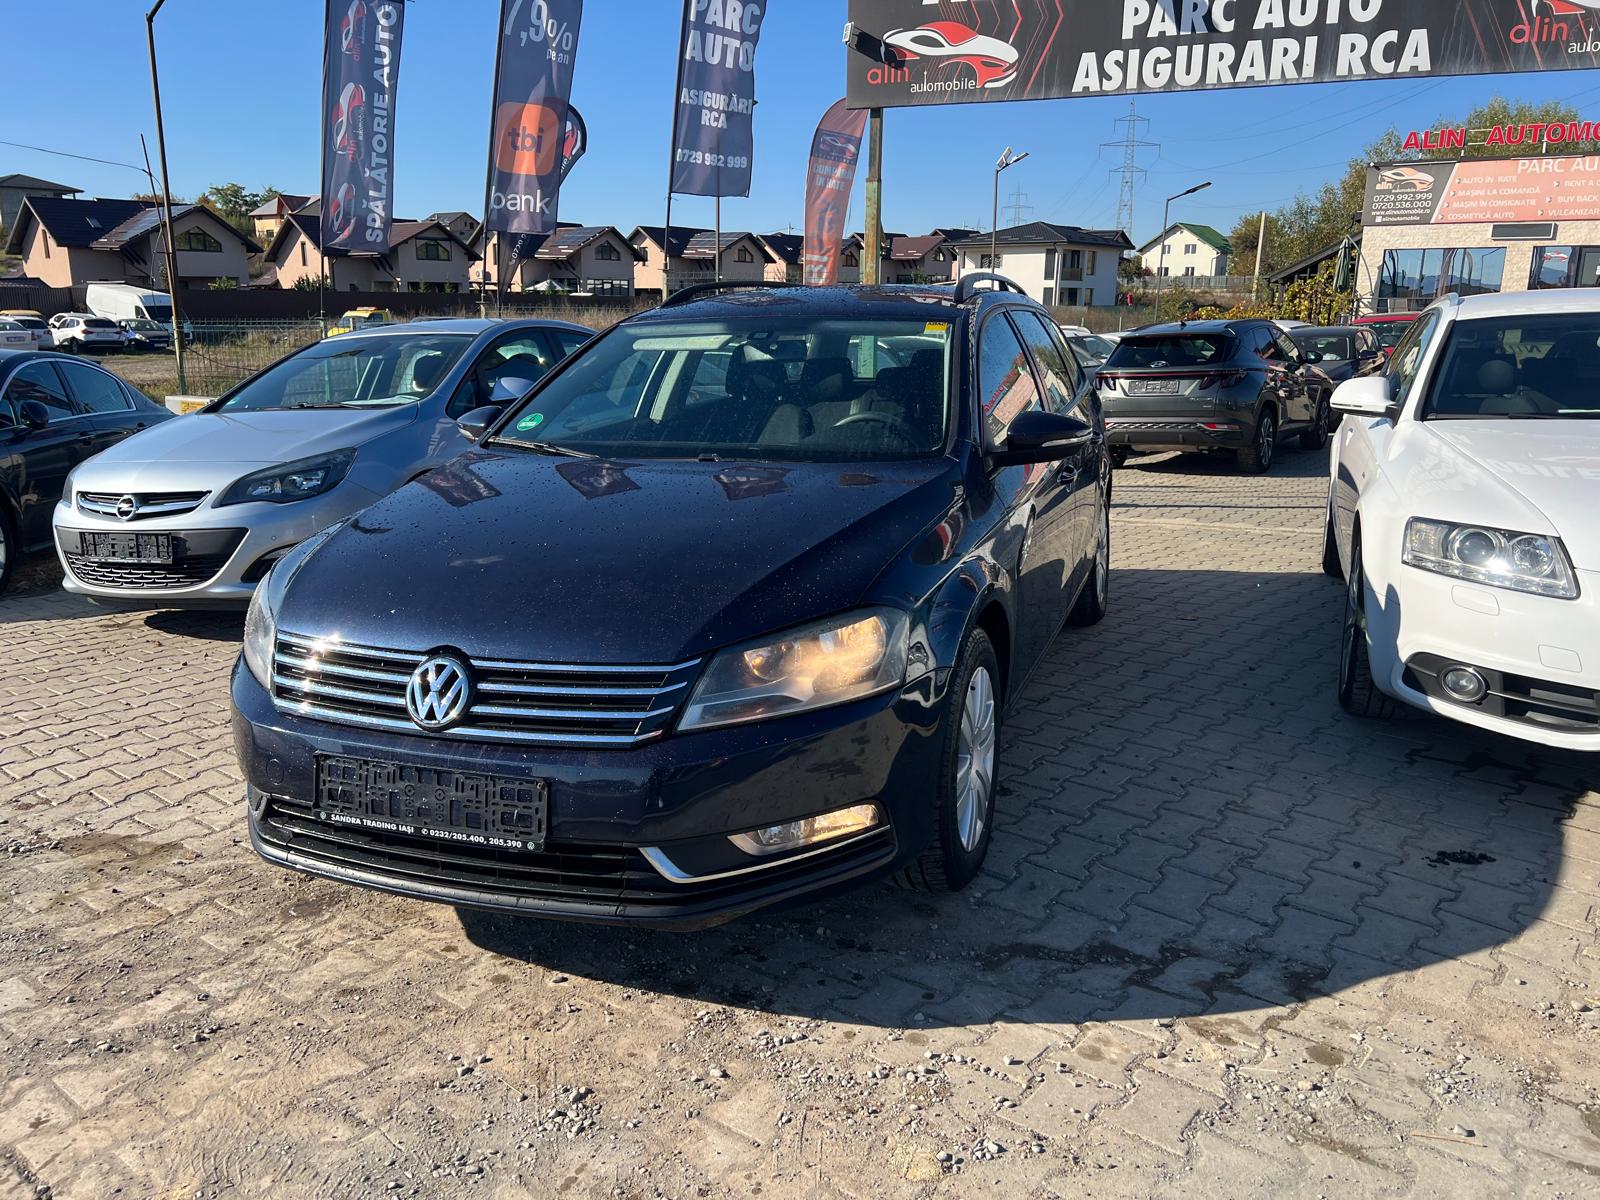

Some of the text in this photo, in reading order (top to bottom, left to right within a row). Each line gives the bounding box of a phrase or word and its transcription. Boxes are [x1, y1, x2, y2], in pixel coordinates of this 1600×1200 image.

[690, 0, 761, 35] PARC
[1121, 0, 1235, 40] PARC
[1509, 15, 1568, 44] alin
[557, 52, 569, 65] an
[685, 29, 754, 72] AUTO
[1071, 28, 1431, 93] ASIGURARI RCA
[866, 62, 910, 85] alin
[910, 71, 976, 93] automobile
[680, 87, 753, 114] ASIGURĂRI
[361, 4, 397, 243] SPĂLĂTORIE AUTO
[701, 109, 728, 129] RCA
[508, 126, 545, 153] tbi
[1402, 127, 1466, 151] ALIN
[676, 148, 748, 169] 0729 992 999
[1517, 158, 1566, 174] PARC
[490, 185, 551, 215] bank
[1371, 200, 1432, 210] 0720.536.000
[1373, 192, 1433, 202] 0729.992.999
[330, 813, 362, 825] SANDRA
[362, 818, 397, 831] TRADING
[429, 829, 487, 845] 0232/205.400,
